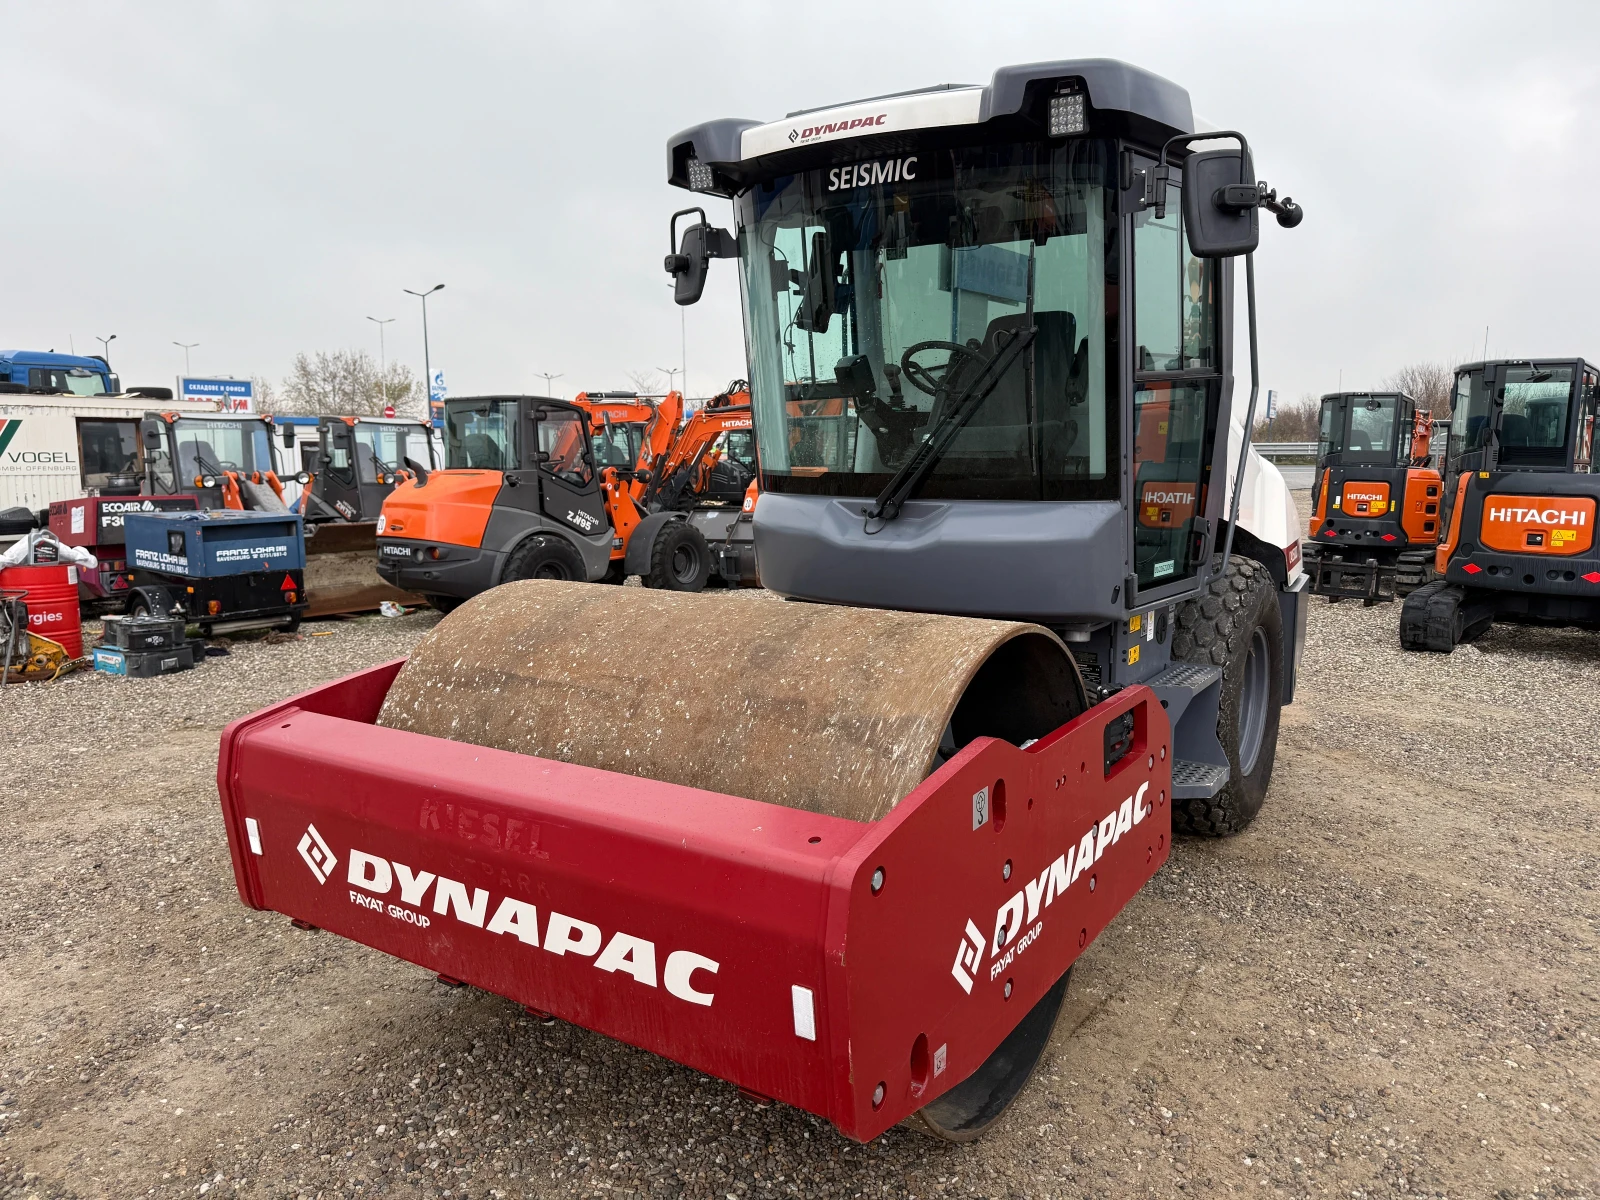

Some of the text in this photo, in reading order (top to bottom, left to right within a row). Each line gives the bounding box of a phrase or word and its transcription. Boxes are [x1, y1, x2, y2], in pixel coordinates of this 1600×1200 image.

[800, 114, 887, 139] DYNAPAC
[828, 156, 917, 191] SEISMIC
[596, 410, 628, 418] HIACHI
[721, 419, 752, 427] HITACH
[8, 452, 76, 463] VOGEL
[1347, 493, 1383, 501] HITACHI
[102, 502, 141, 513] ECOAIR
[577, 509, 599, 526] HITACHI
[1489, 507, 1587, 526] HITACHI
[377, 518, 385, 531] 20
[135, 549, 158, 561] FRANZ
[159, 553, 178, 564] LOHR
[216, 548, 249, 557] FRANZ
[250, 546, 275, 554] LOHR
[216, 554, 250, 562] RAVENSBURG
[383, 546, 411, 556] HITACHI
[29, 611, 63, 626] rgies
[419, 798, 550, 861] KIESEL
[991, 780, 1150, 959] DYNAPAC
[349, 889, 431, 930] FAYAT GROUP
[346, 848, 720, 1008] DYNAPAC
[990, 921, 1043, 982] FAYAT GROUP
